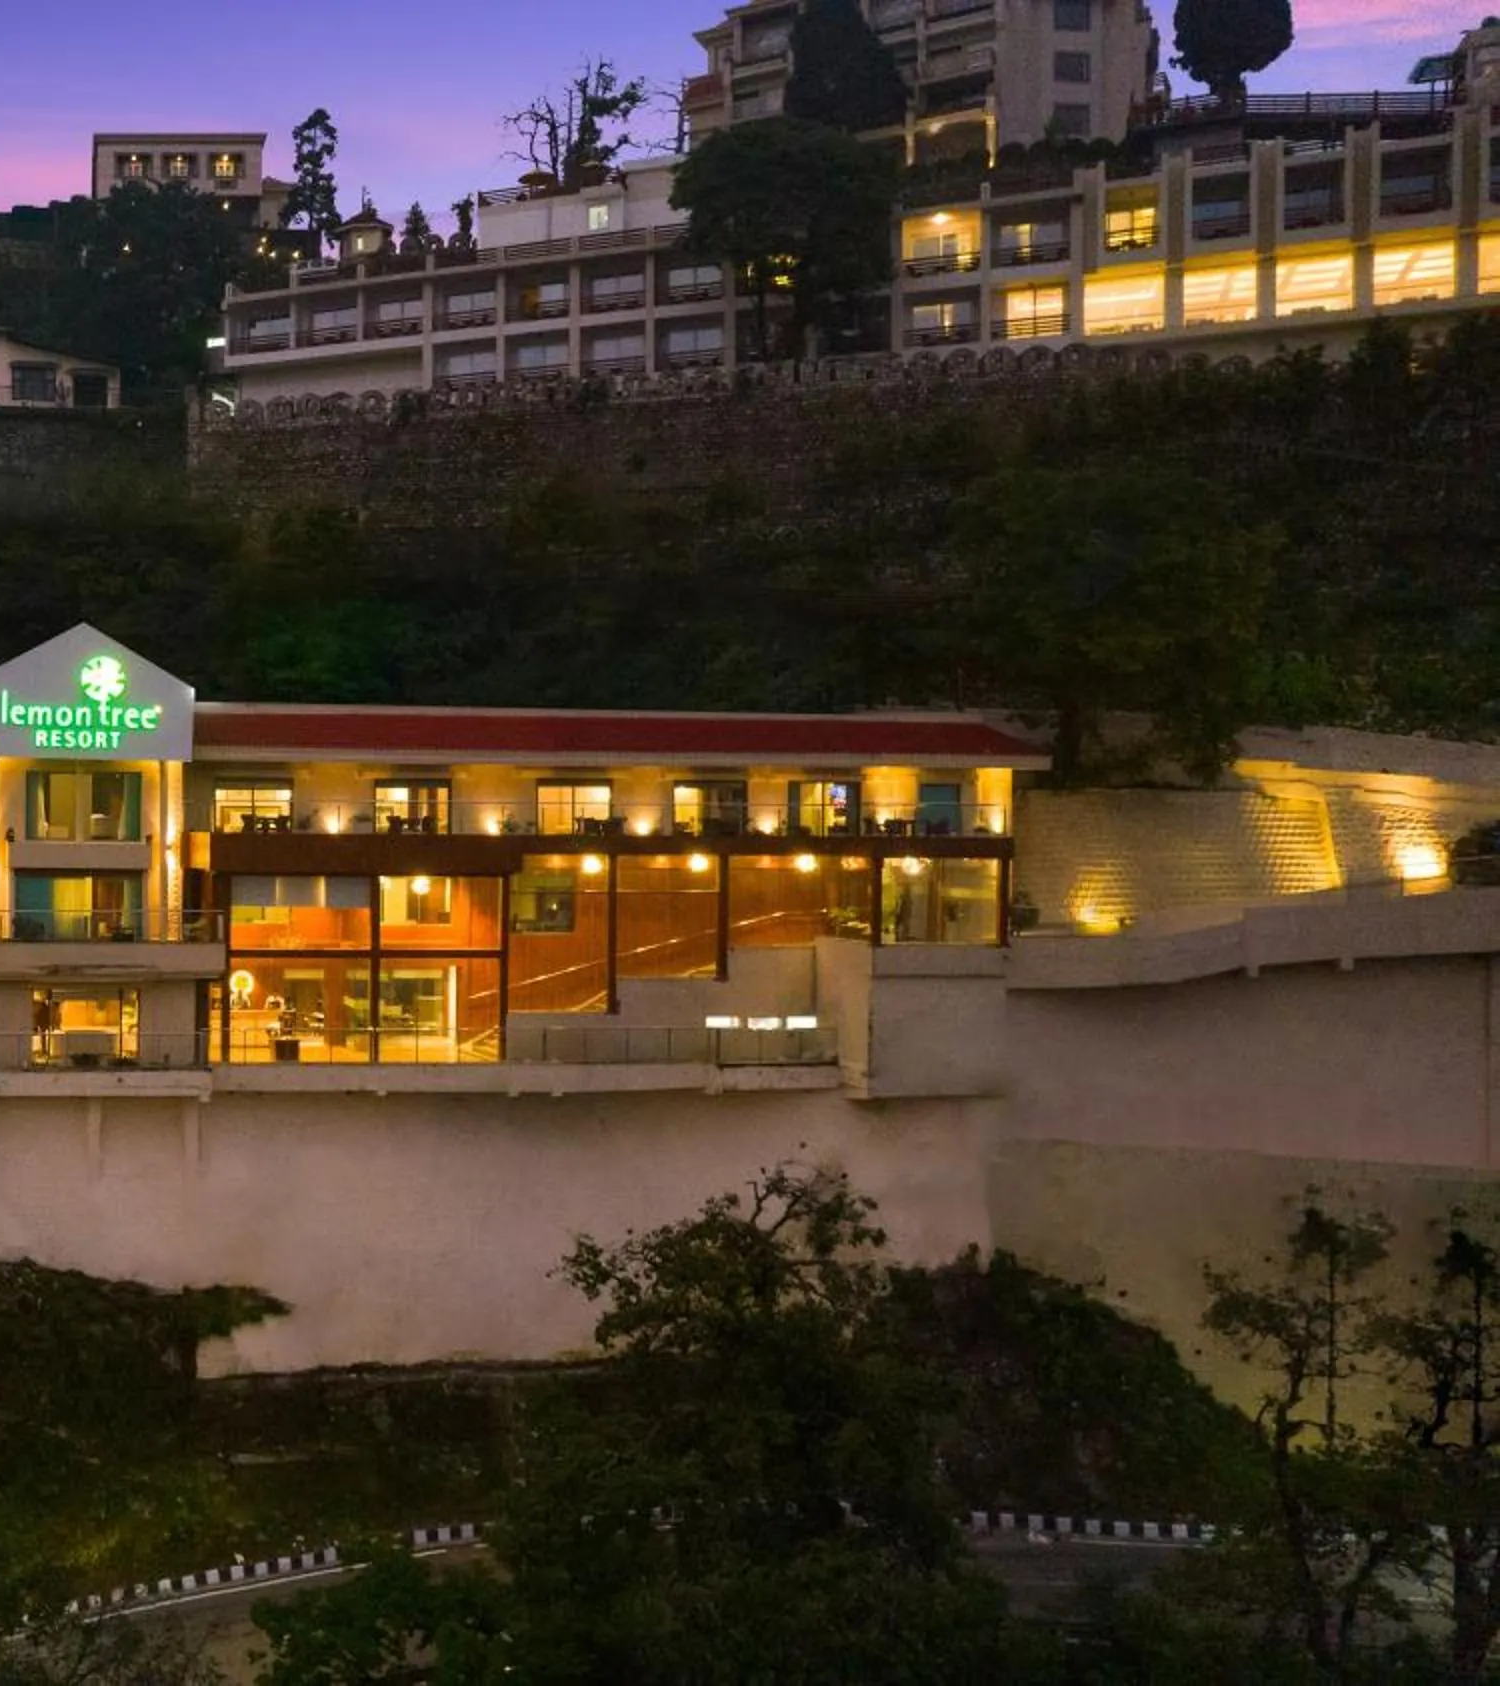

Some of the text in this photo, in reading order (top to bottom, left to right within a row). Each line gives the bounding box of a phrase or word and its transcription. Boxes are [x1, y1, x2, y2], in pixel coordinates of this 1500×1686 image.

[1, 689, 158, 729] lemon tree
[35, 730, 121, 748] RESORT
